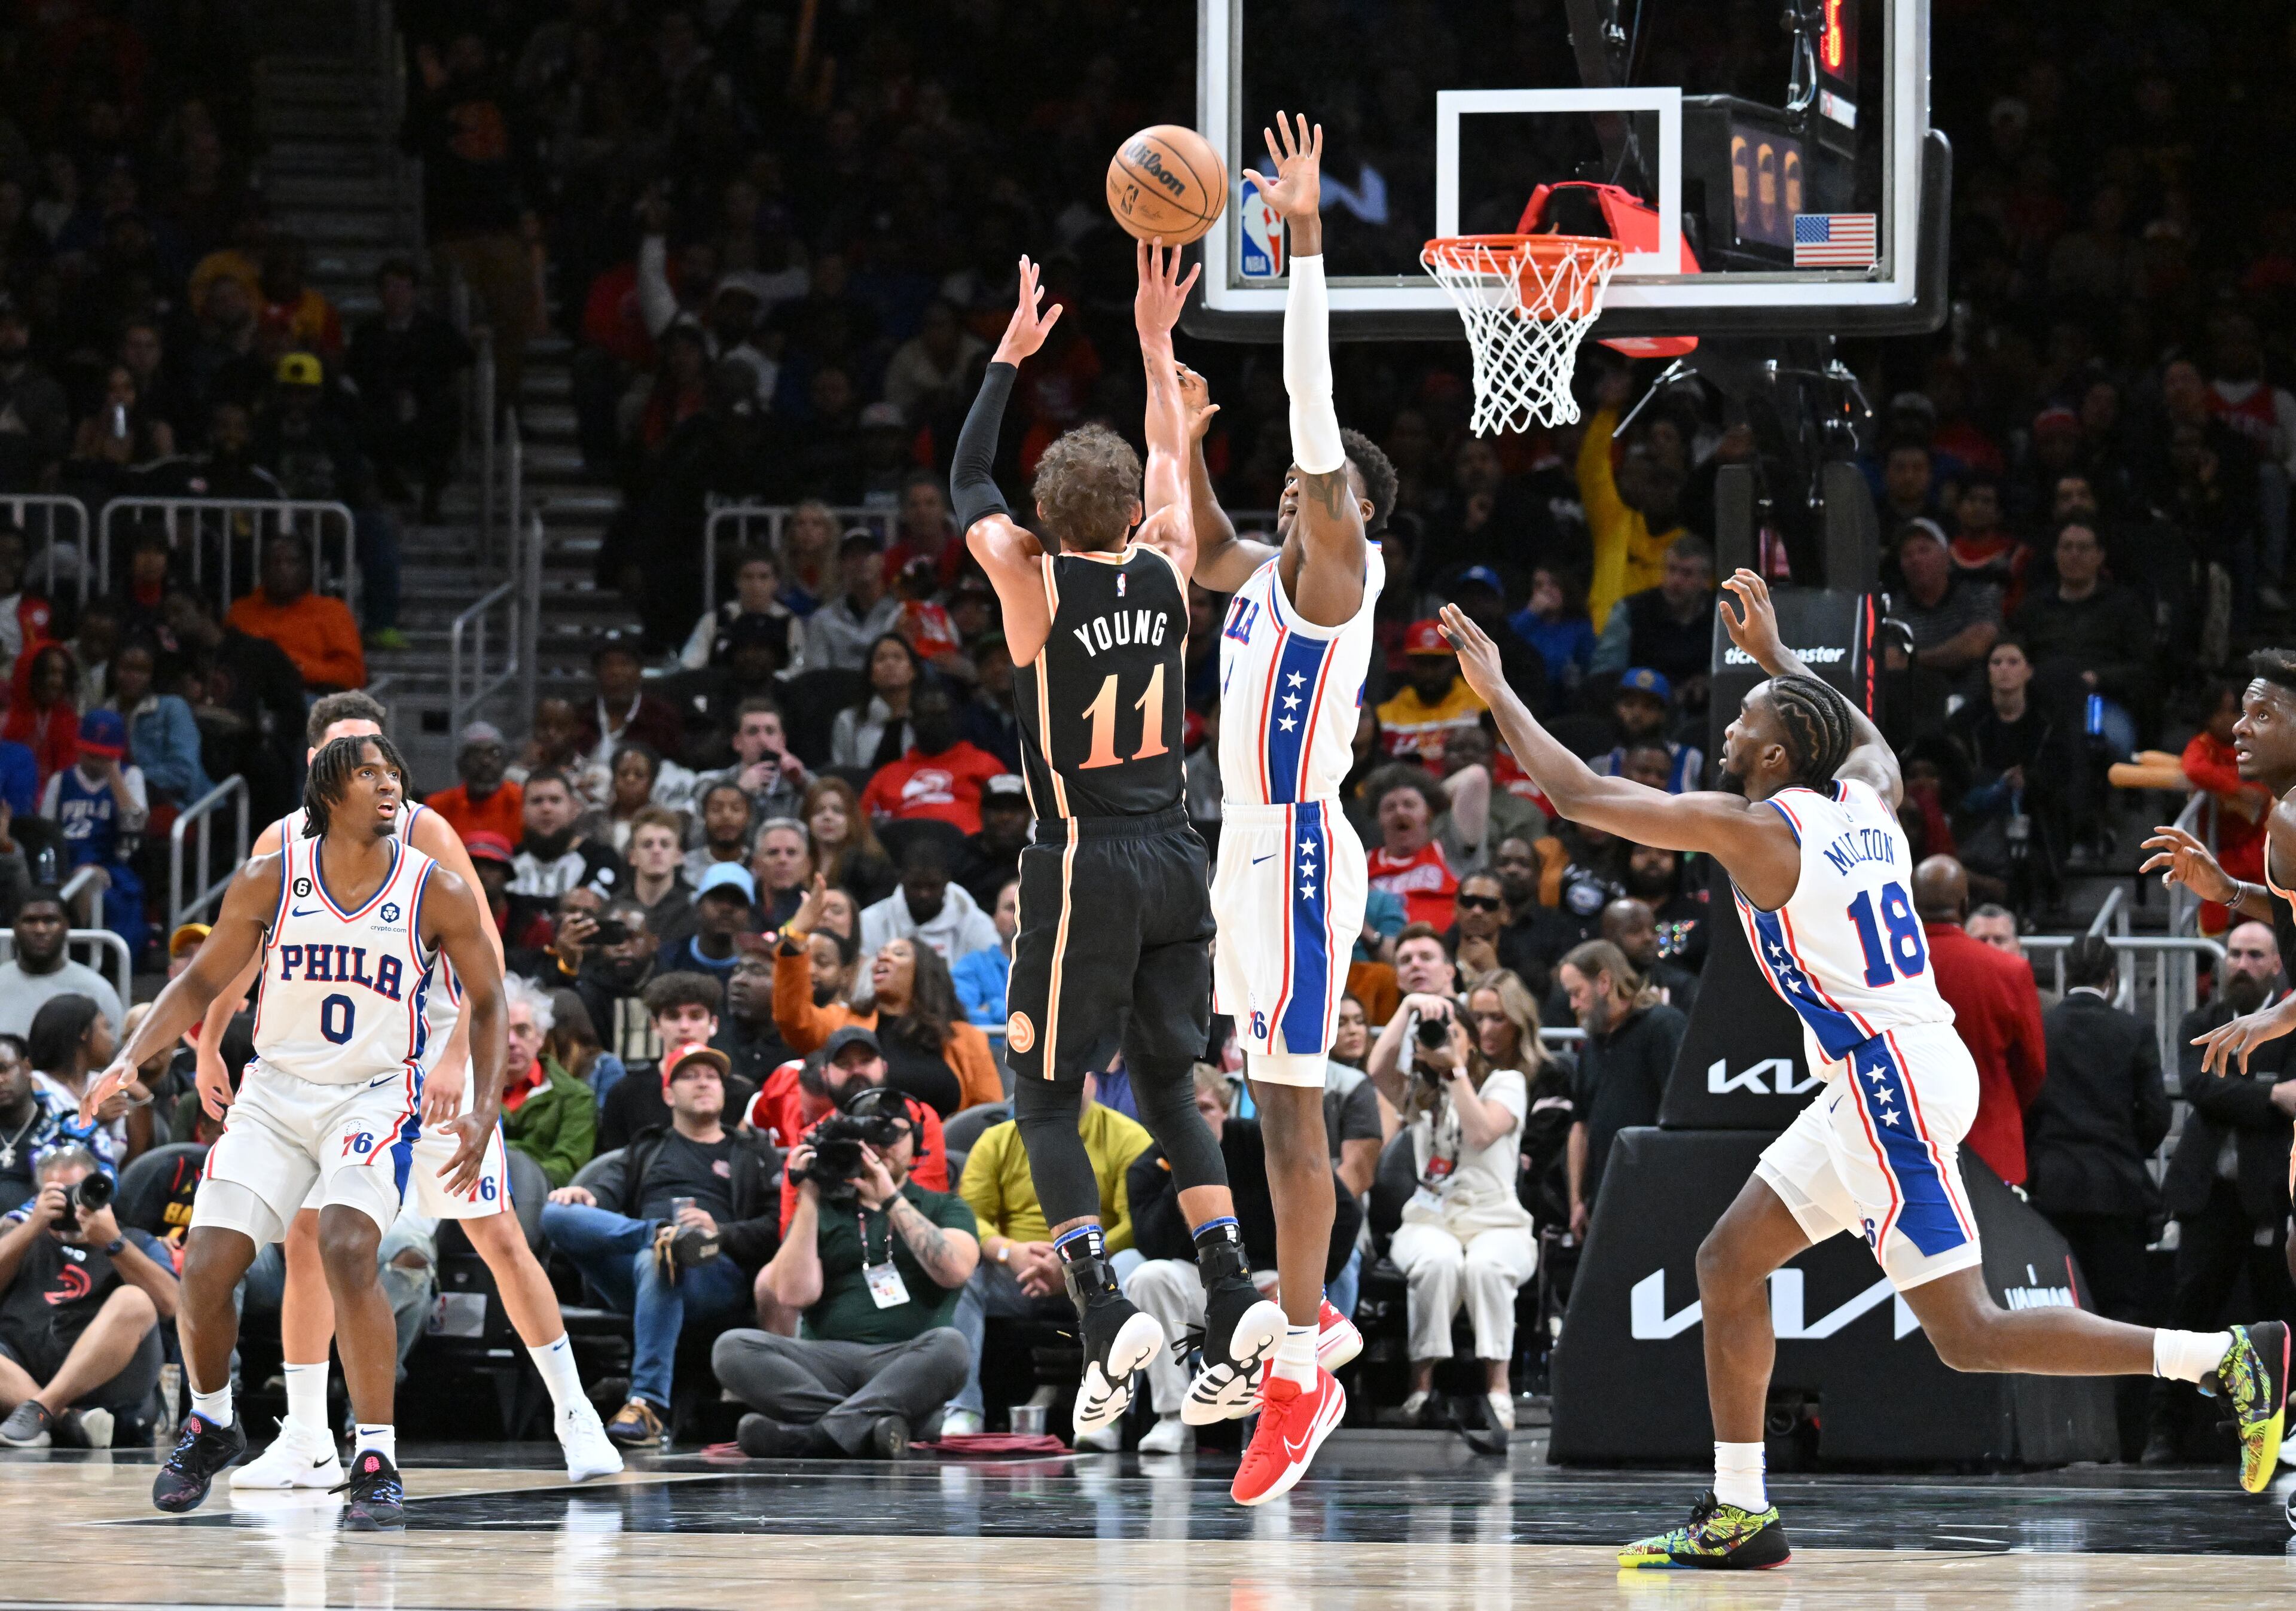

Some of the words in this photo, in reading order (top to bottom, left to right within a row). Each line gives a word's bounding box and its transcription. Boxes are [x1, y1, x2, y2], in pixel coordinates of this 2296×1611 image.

[1125, 141, 1186, 198] Wilson
[1245, 255, 1267, 273] NBA
[1073, 609, 1168, 657] YOUNG
[1724, 645, 1846, 665] ticaster
[1078, 663, 1169, 770] 11
[1822, 828, 1894, 877] MILTON
[297, 880, 309, 896] 6
[370, 925, 407, 934] crypto.com
[1846, 881, 1925, 988] 18
[280, 944, 403, 1002] PHILA
[320, 993, 356, 1045] 0
[1248, 1009, 1268, 1039] 76
[1708, 1058, 1822, 1094] KI
[341, 1131, 374, 1158] 76
